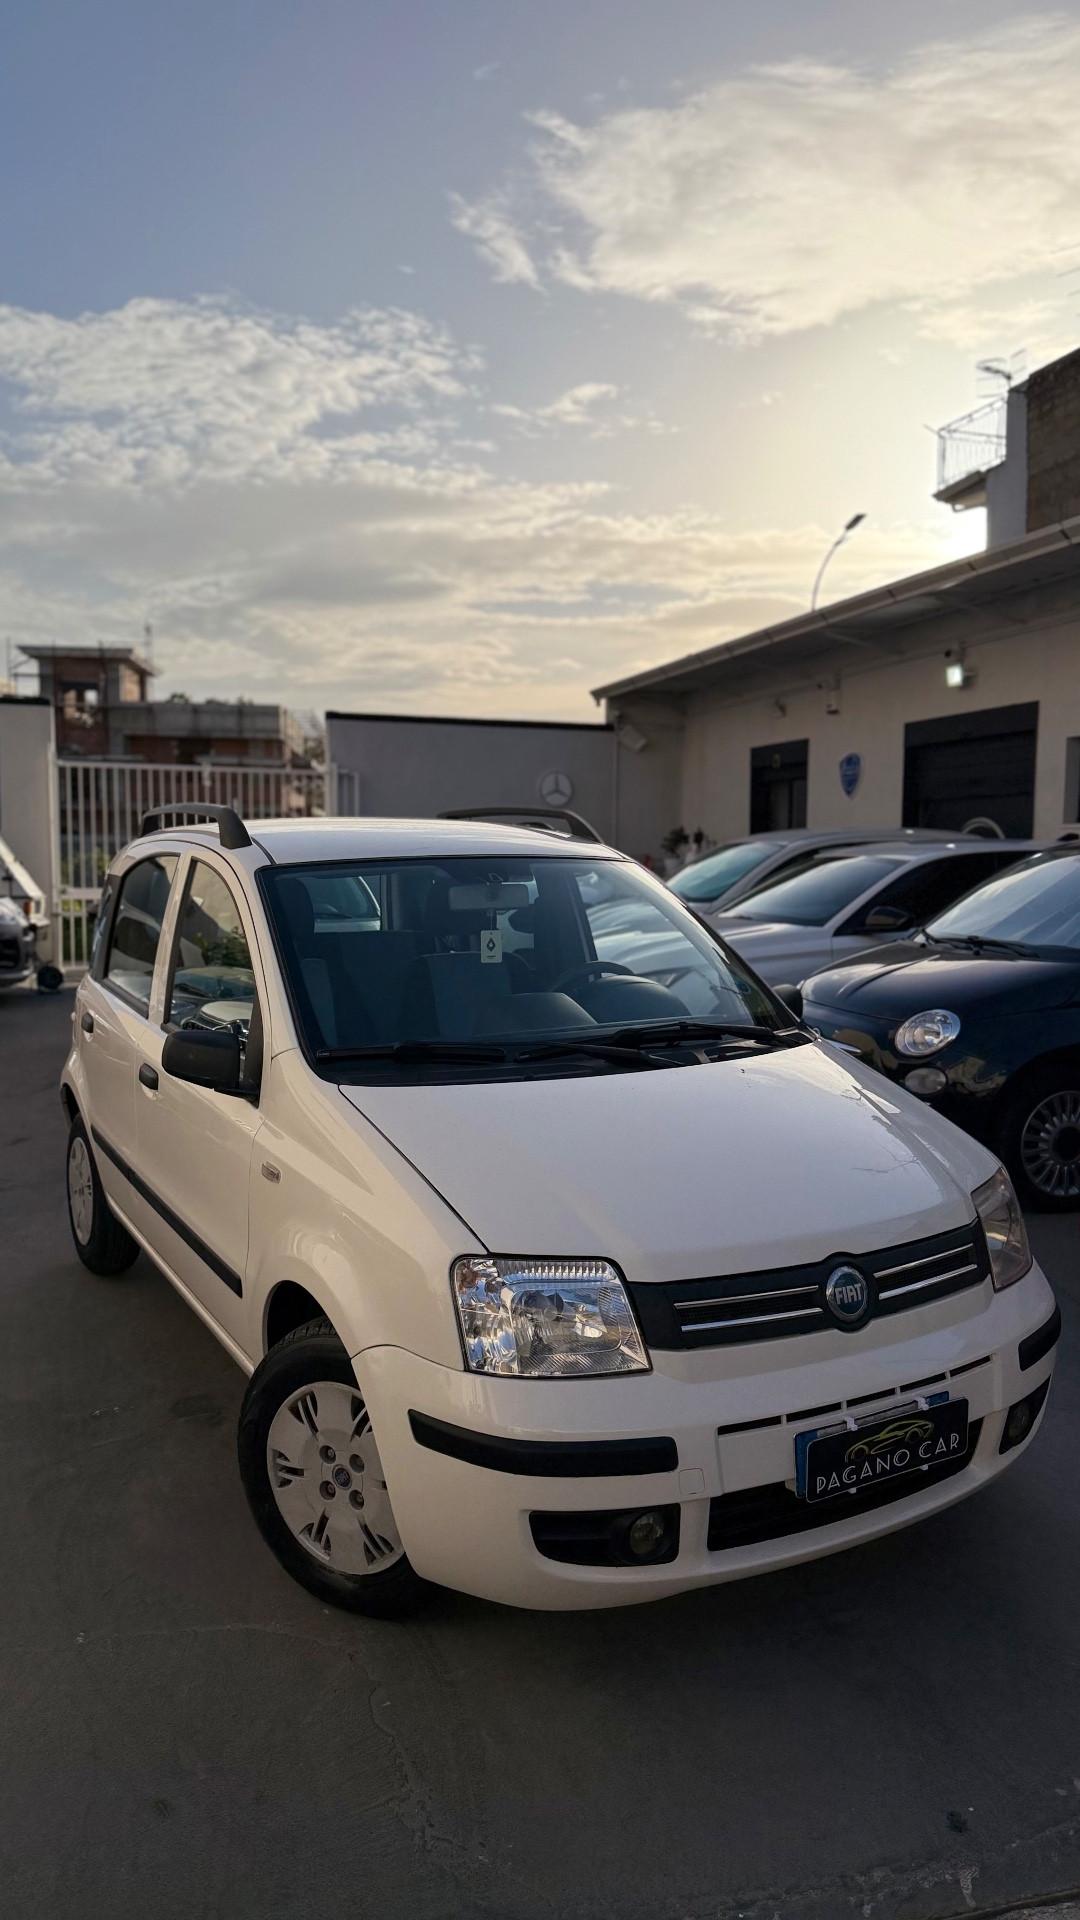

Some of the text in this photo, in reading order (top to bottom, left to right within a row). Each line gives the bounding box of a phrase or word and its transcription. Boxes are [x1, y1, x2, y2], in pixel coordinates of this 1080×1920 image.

[834, 1283, 862, 1305] FIAT
[816, 1433, 960, 1494] PAGANO CAR
